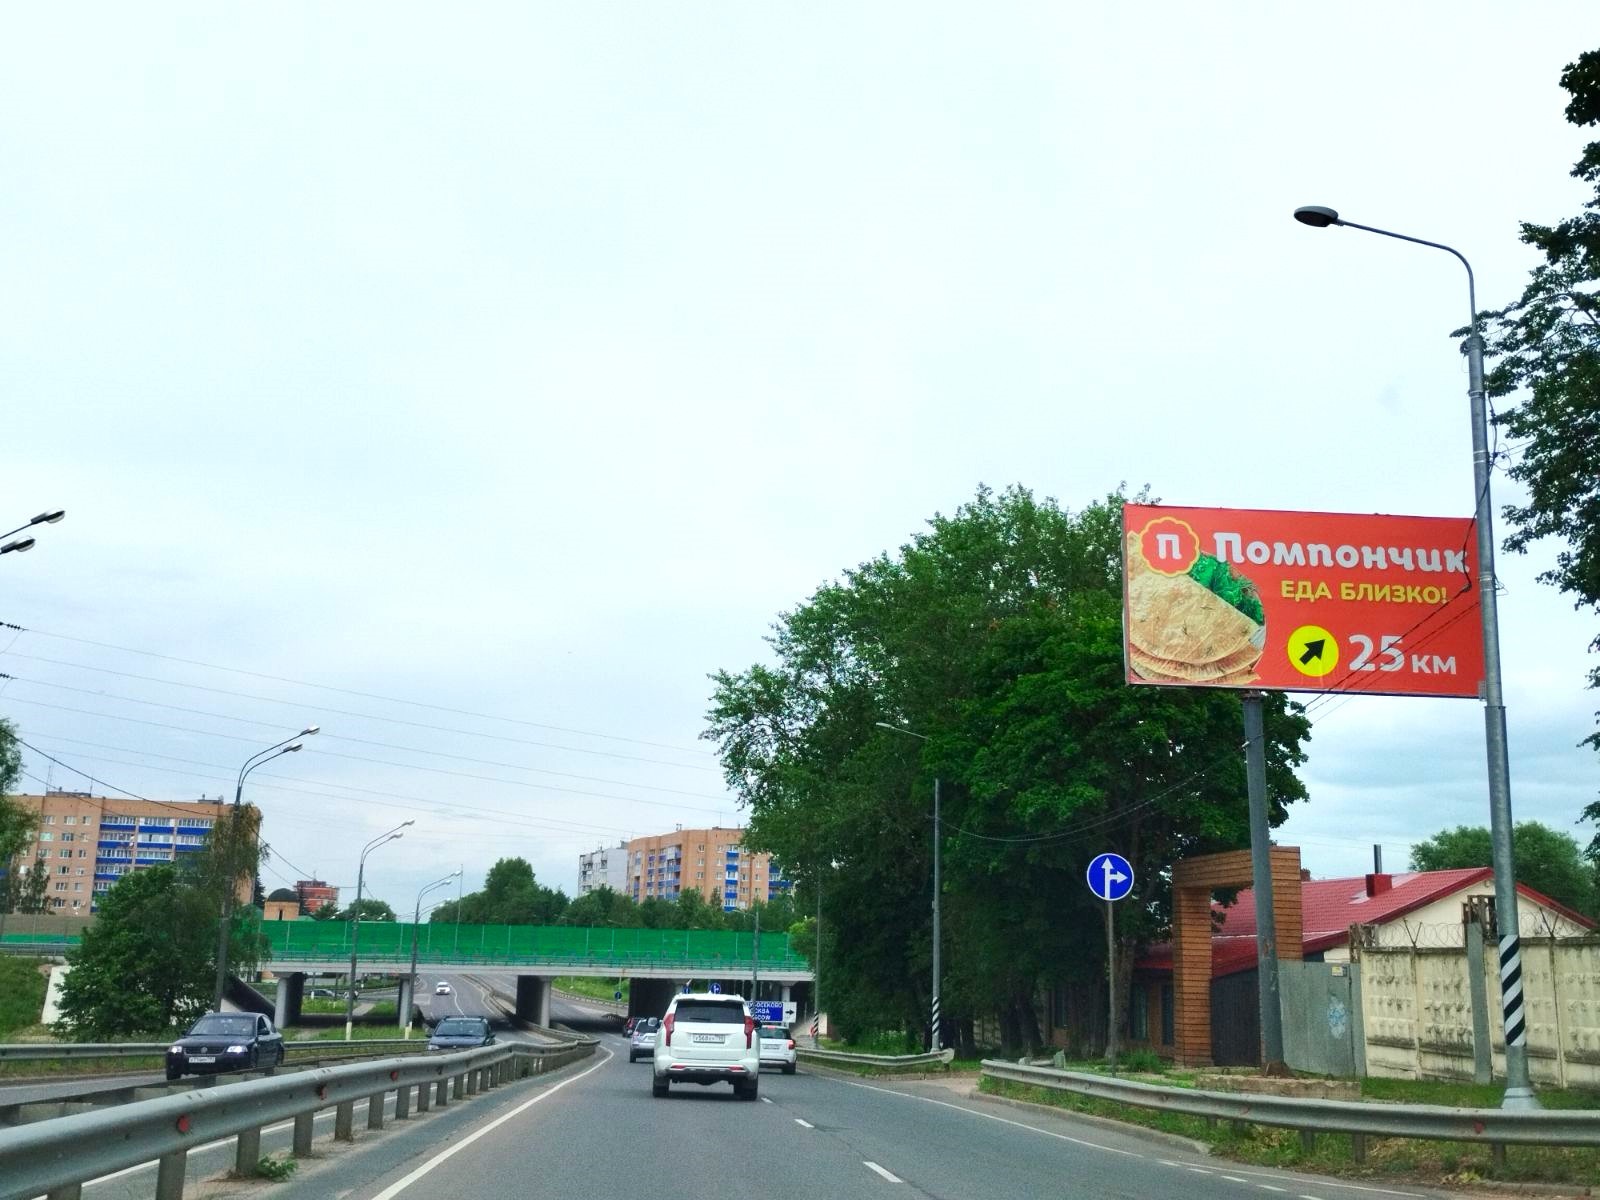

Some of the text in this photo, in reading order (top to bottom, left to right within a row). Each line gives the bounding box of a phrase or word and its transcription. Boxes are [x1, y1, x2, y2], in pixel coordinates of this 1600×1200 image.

[1213, 531, 1470, 574] Помпончик
[1280, 580, 1448, 604] ЕДА БЛИЗКО!
[1348, 634, 1405, 672] 25
